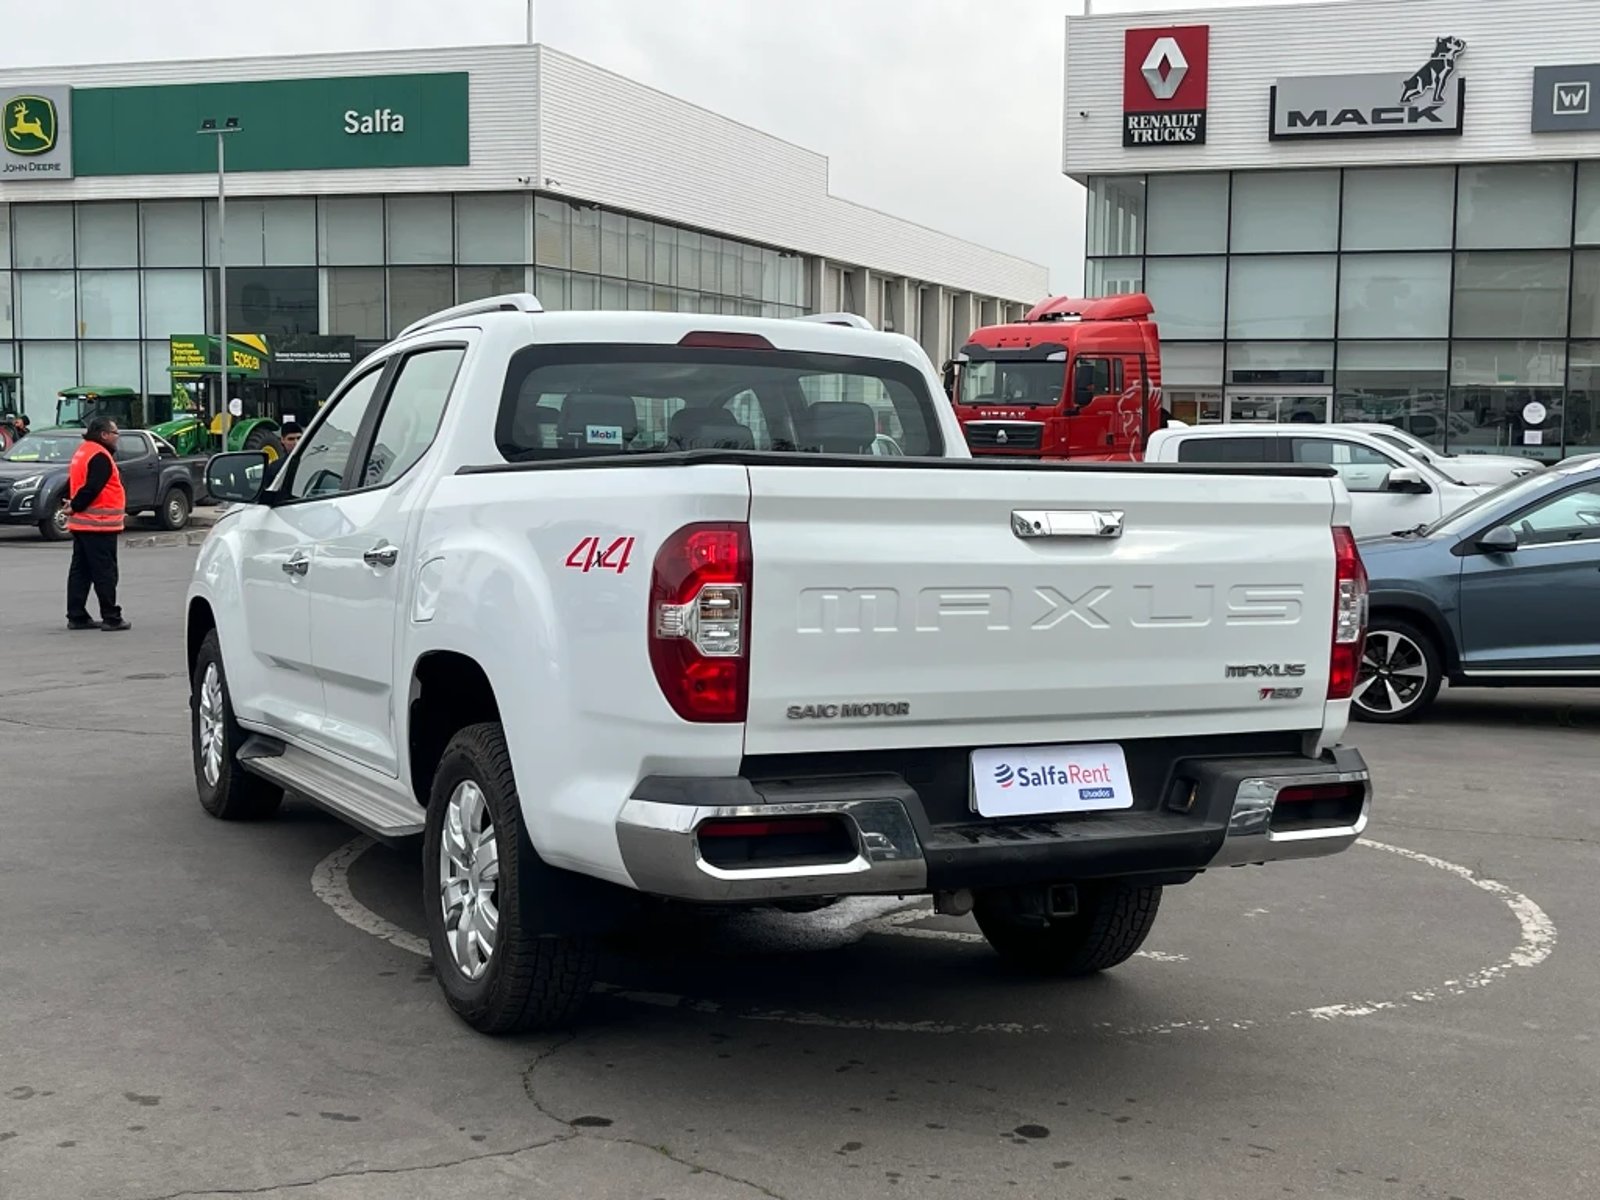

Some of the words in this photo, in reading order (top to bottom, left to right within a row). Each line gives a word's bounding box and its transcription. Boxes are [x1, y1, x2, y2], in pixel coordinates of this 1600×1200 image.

[344, 109, 404, 134] Salfa
[1128, 113, 1202, 129] RENAULT
[1287, 106, 1443, 127] MACK
[1131, 127, 1196, 143] TRUCKS
[3, 163, 28, 173] JOHN
[29, 161, 61, 172] DEERE
[591, 430, 617, 440] Mobil
[565, 536, 635, 574] 4x4
[797, 584, 1304, 633] MAXUS
[1225, 663, 1306, 678] MAXUS
[787, 704, 839, 720] SAIC
[840, 701, 910, 718] MOTOR
[1017, 763, 1111, 787] SalfaRent
